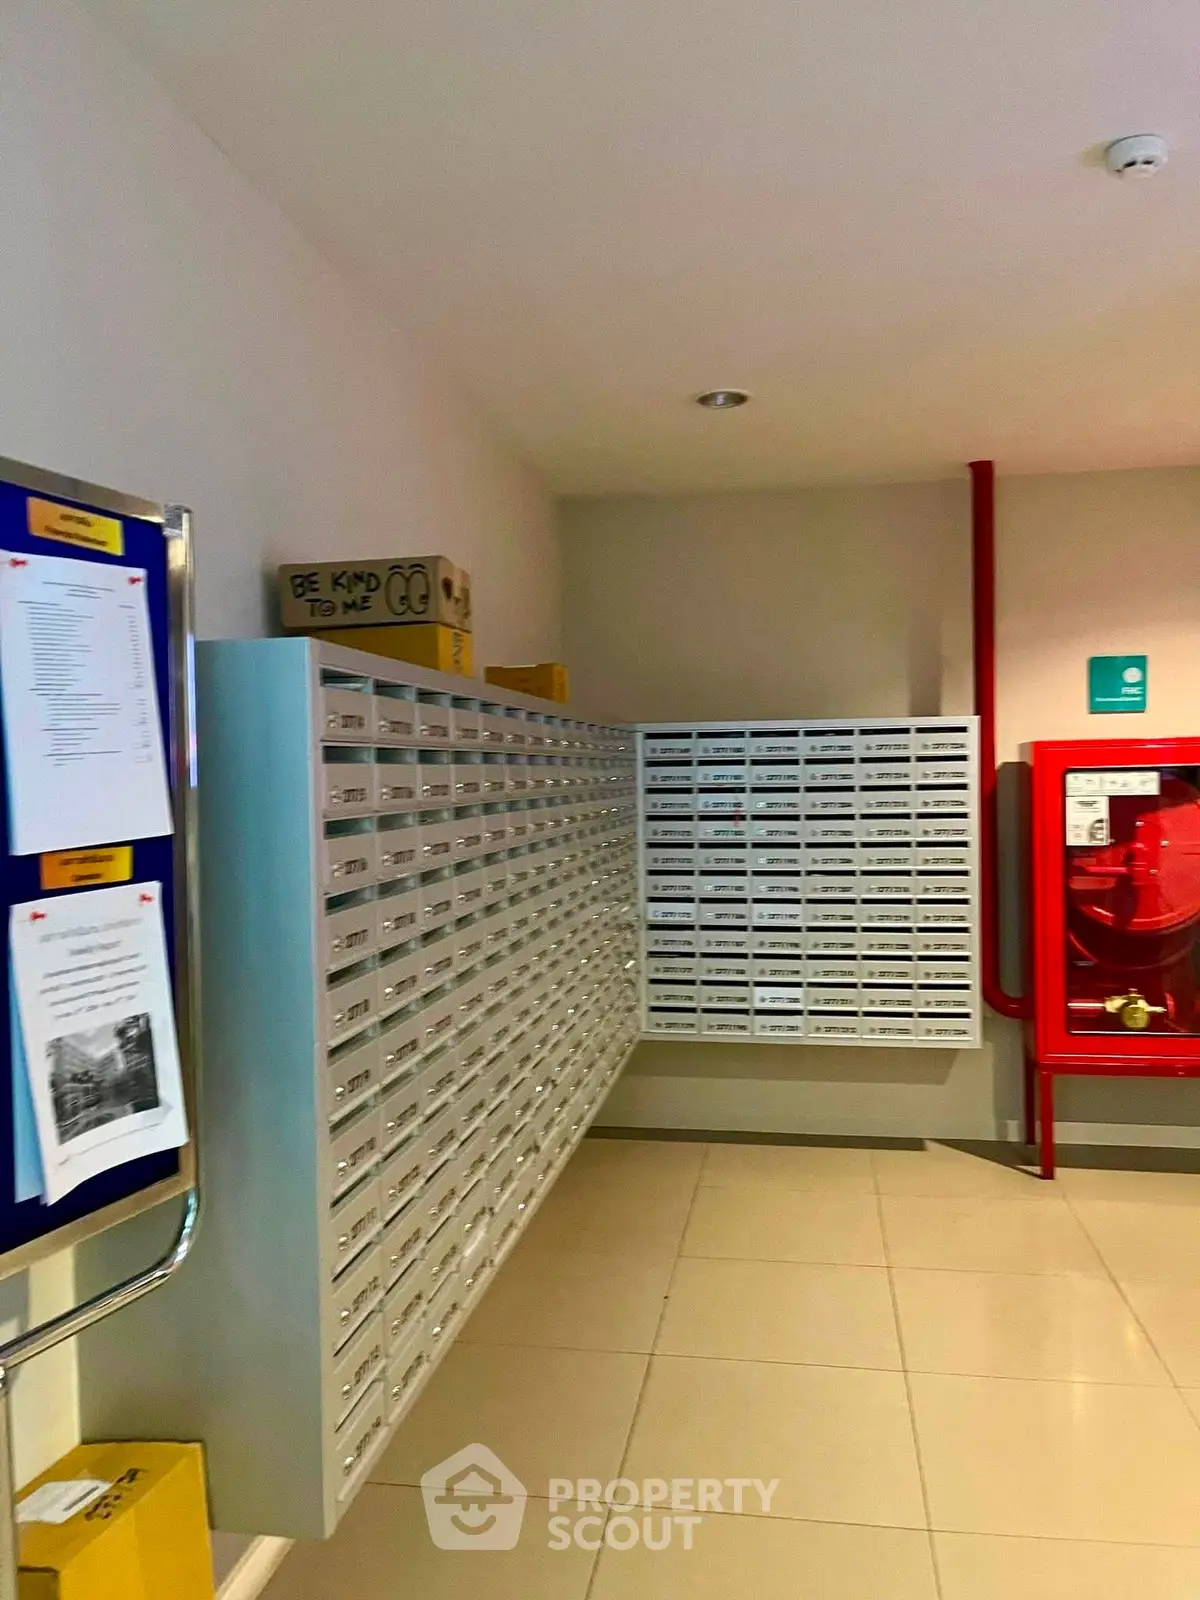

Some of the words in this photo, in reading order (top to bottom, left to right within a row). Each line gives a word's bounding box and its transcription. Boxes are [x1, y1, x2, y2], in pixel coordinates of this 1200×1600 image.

[290, 571, 320, 599] BE
[331, 569, 381, 594] KIND
[342, 595, 372, 615] ME
